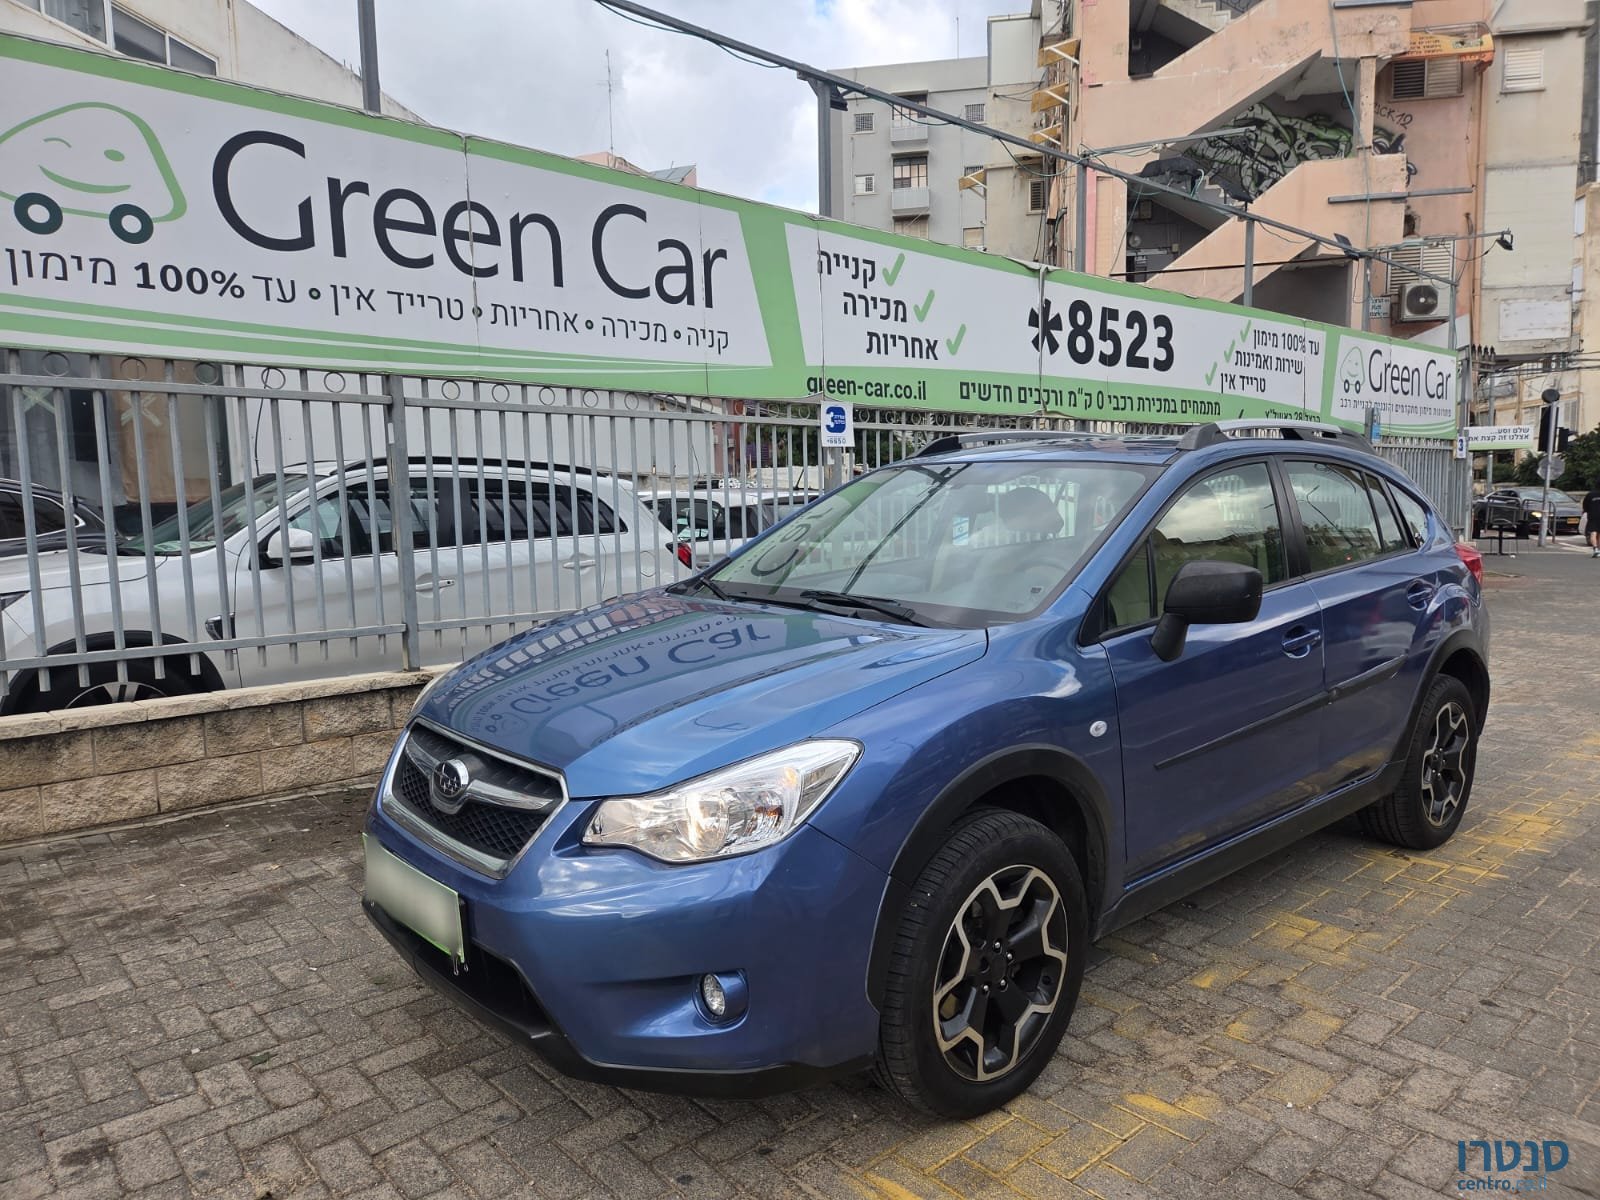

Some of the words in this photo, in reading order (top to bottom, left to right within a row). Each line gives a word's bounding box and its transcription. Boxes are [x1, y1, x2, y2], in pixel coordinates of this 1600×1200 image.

[212, 130, 563, 288] Green
[592, 203, 728, 308] Car
[5, 248, 117, 286] מימון
[818, 250, 876, 289] קנייה
[134, 261, 245, 299] 100%
[252, 275, 296, 303] עד
[330, 284, 376, 316] אין
[387, 290, 464, 321] טרייד
[843, 291, 907, 323] מכירה
[490, 301, 579, 334] אחריות
[602, 317, 668, 343] מכירה
[687, 326, 729, 355] קניה
[1253, 329, 1279, 350] מימון
[866, 331, 939, 361] אחריות
[1281, 332, 1306, 354] 100%
[1308, 340, 1320, 356] עד
[1235, 350, 1273, 371] ואמינות
[1275, 356, 1303, 375] שירות
[1220, 372, 1237, 395] אין
[1240, 374, 1266, 393] טרייד
[1368, 349, 1421, 397] Green
[1425, 359, 1451, 400] Car
[807, 376, 927, 400] green-car.co.il
[959, 381, 1013, 402] חדשים
[1018, 386, 1063, 406] ורכבים
[1096, 390, 1104, 410] 0
[1108, 394, 1134, 412] רכבי
[1136, 396, 1178, 414] במכירת
[1180, 399, 1221, 416] מתמחים
